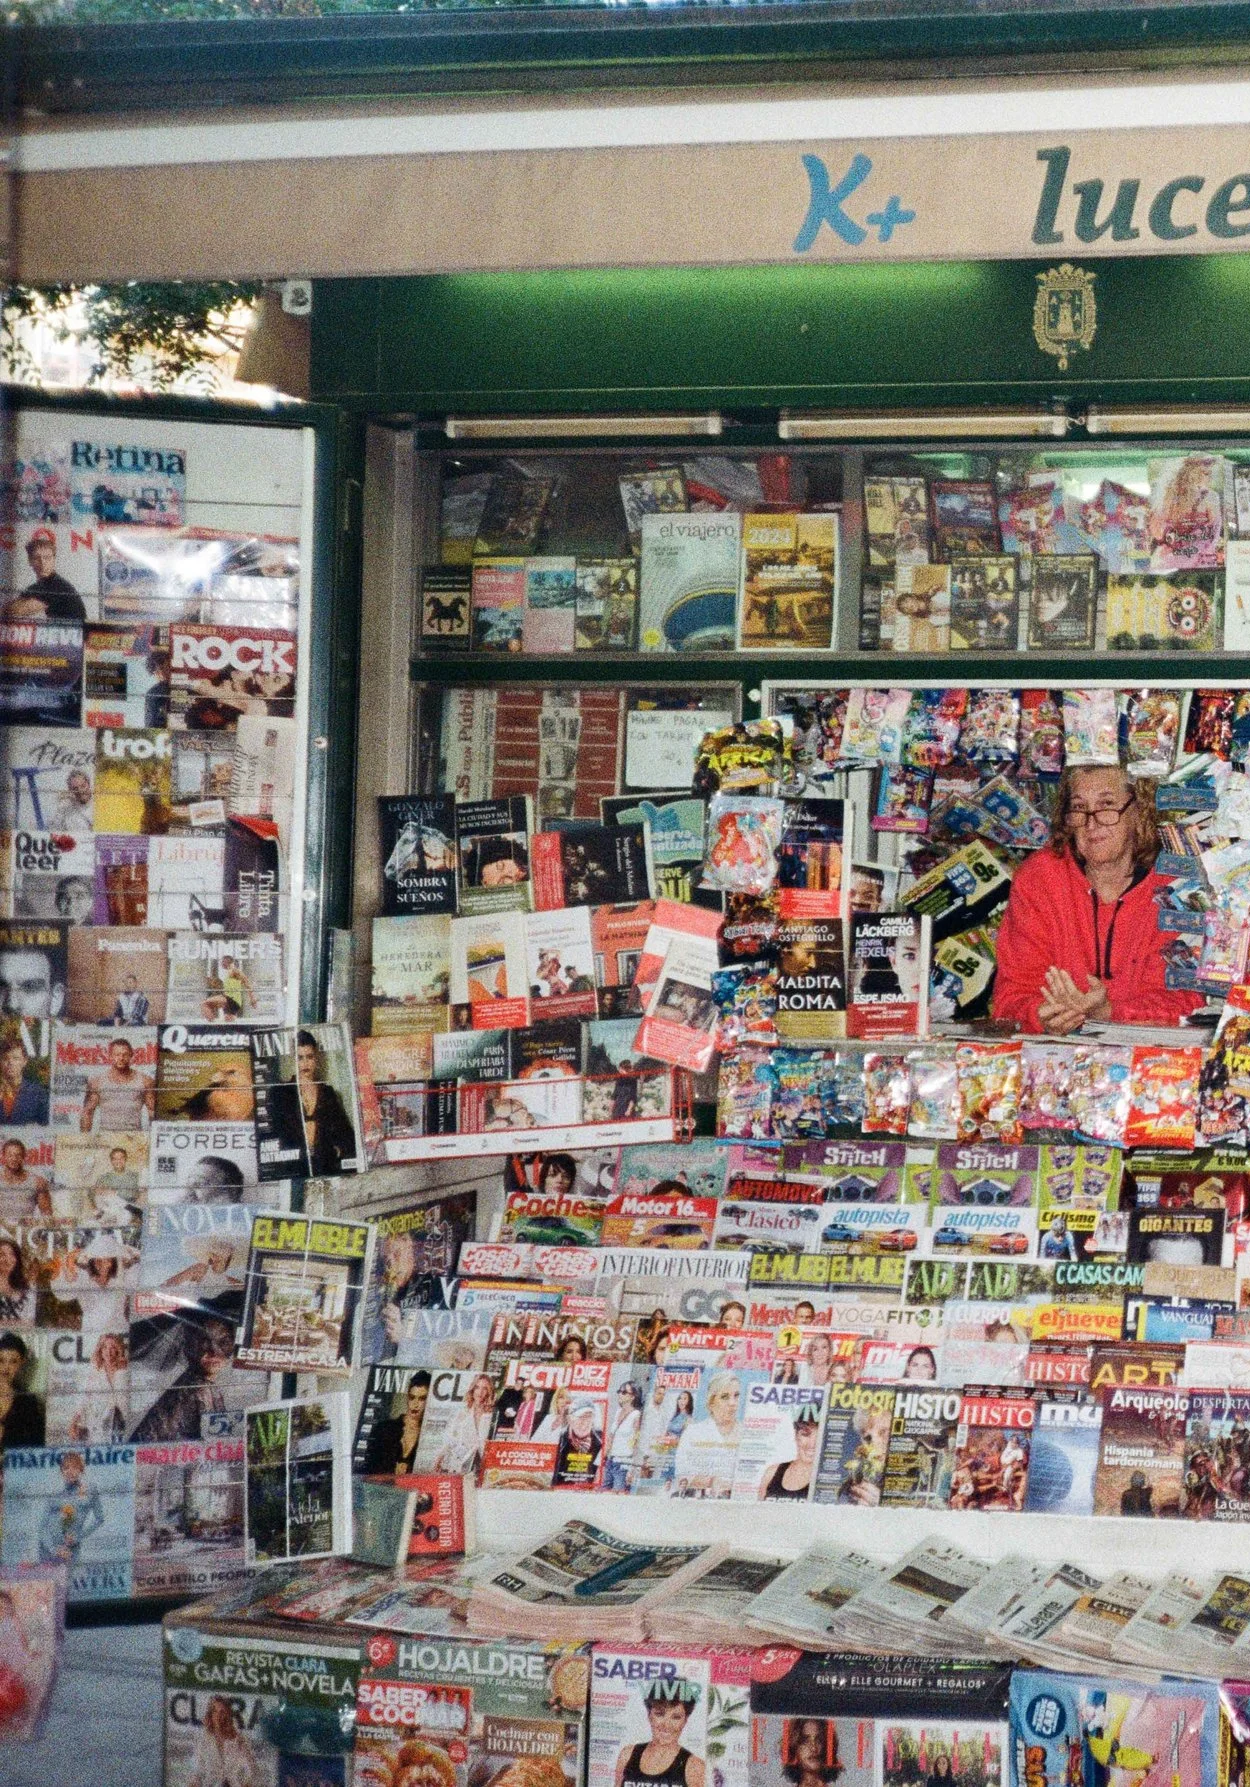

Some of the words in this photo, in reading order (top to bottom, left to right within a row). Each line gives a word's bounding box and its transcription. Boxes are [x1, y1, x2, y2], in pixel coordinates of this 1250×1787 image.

[71, 441, 185, 475] Retina
[659, 521, 676, 539] el
[679, 520, 736, 541] viajero
[749, 527, 793, 545] 2024
[171, 633, 293, 674] ROCK
[397, 877, 448, 889] SOMBRA
[238, 868, 256, 918] Libre
[256, 868, 276, 918] Tinta
[397, 890, 445, 904] SUEÑOS
[880, 916, 914, 927] CAMILLA
[856, 925, 914, 938] LÄCKBERG
[381, 949, 442, 961] HEREDERA
[855, 947, 896, 959] FEXEUS
[400, 961, 433, 973] MAR
[779, 993, 836, 1010] ROMA
[621, 1198, 672, 1214] Motor
[675, 1200, 694, 1215] 16
[832, 1207, 910, 1229] autopista
[943, 1210, 1021, 1231] autopista
[1139, 1216, 1214, 1233] GIGANTES
[1068, 1263, 1111, 1285] CASAS
[575, 1366, 608, 1380] DIEZ
[656, 1370, 699, 1390] SEMANA
[751, 1386, 824, 1405] SABER
[1110, 1389, 1189, 1412] Arqueolo
[1193, 1396, 1250, 1412] DESPERTA
[896, 1394, 960, 1421] HISTO
[962, 1404, 1034, 1427] HISTO
[1104, 1445, 1154, 1458] Hispania
[437, 1482, 452, 1515] REINA
[1214, 1498, 1227, 1510] La
[226, 1652, 283, 1668] REVISTA
[285, 1656, 328, 1674] CLARA
[399, 1645, 547, 1681] HOJALDRE
[594, 1658, 677, 1681] SABER
[851, 1675, 872, 1686] ELLE
[874, 1676, 923, 1688] GOURMET
[358, 1684, 428, 1704] SABER
[487, 1724, 531, 1740] Cocinar
[487, 1736, 559, 1756] HOJALDRE
